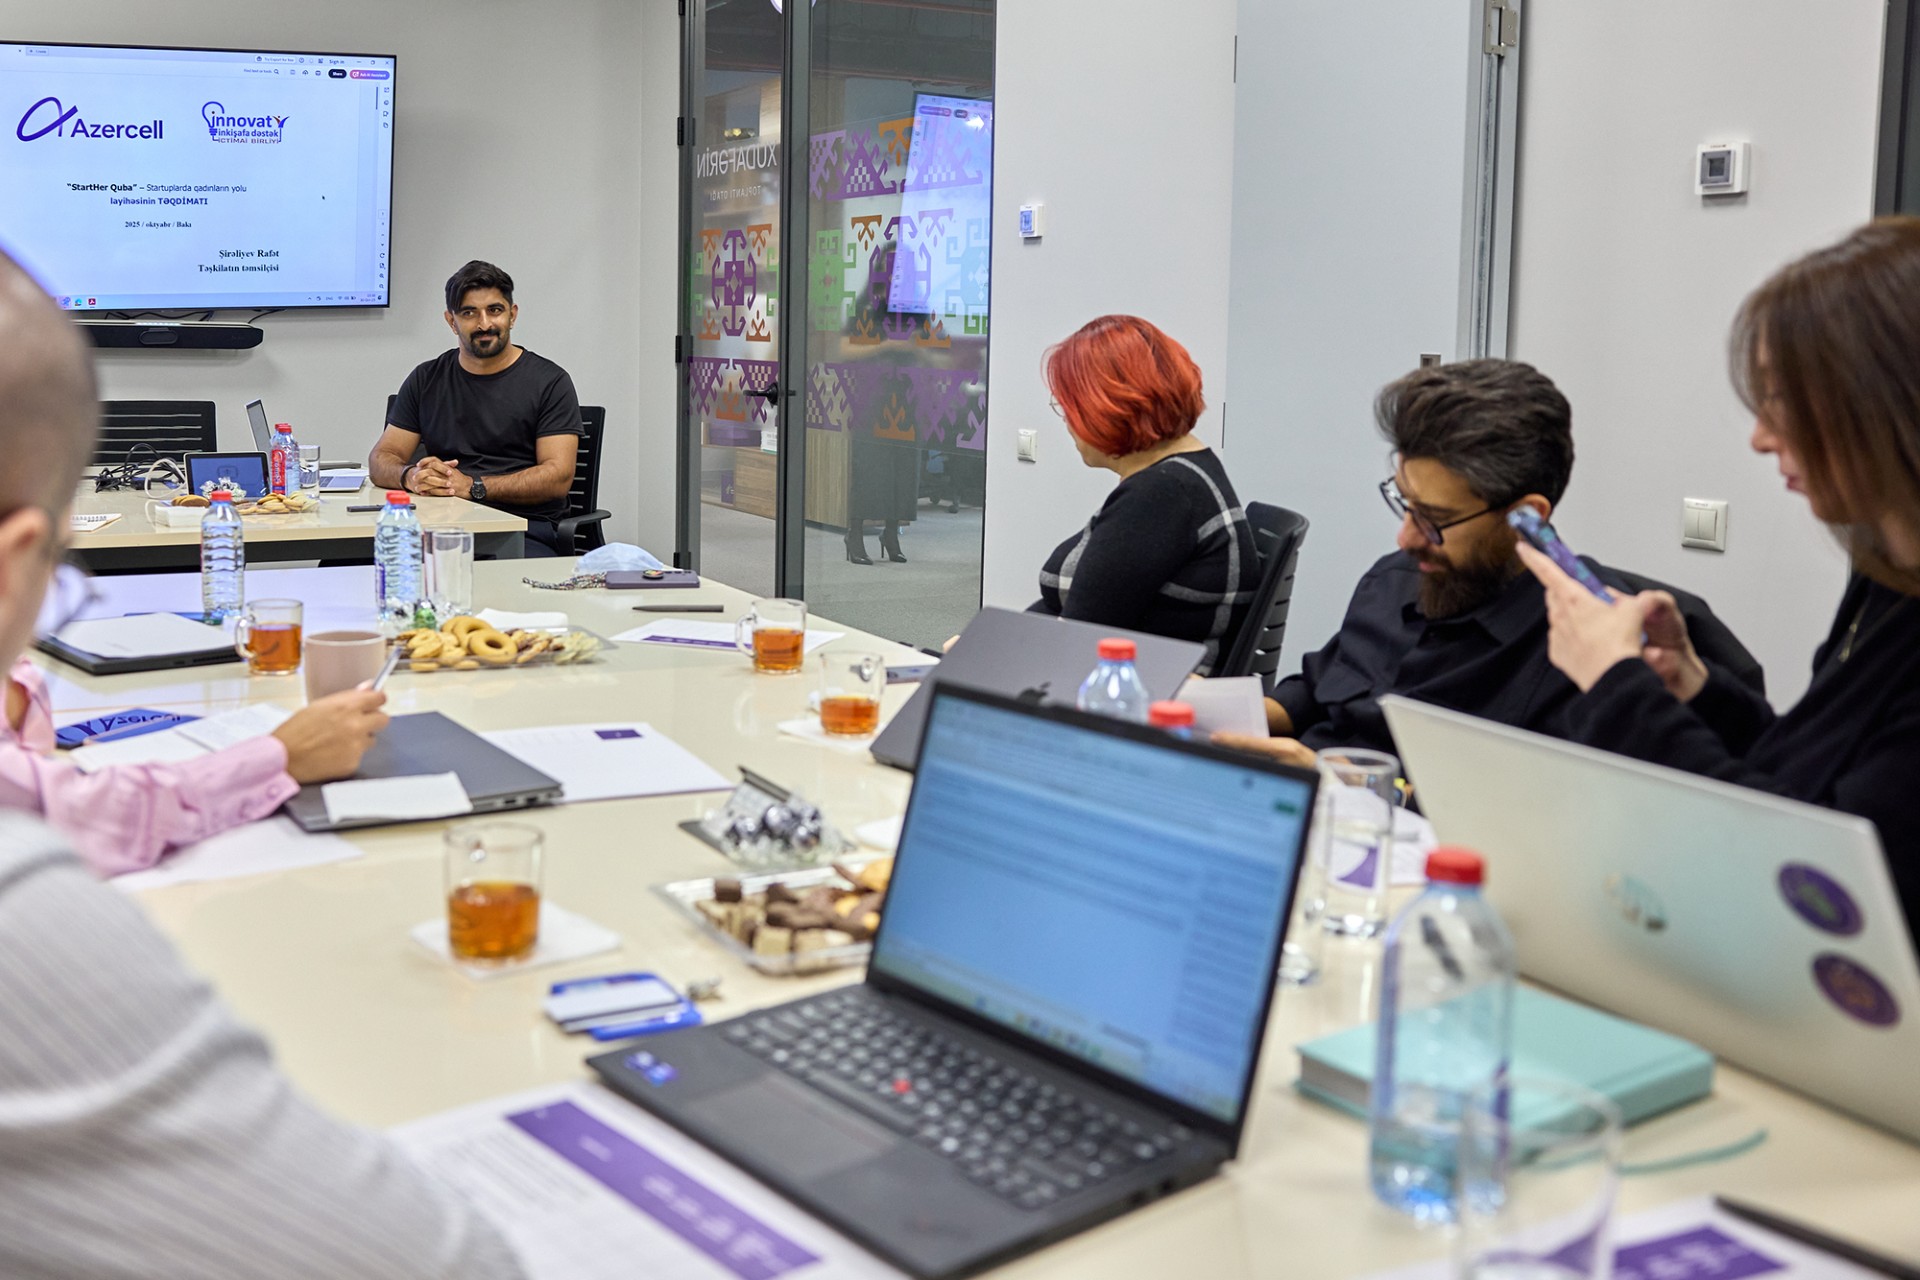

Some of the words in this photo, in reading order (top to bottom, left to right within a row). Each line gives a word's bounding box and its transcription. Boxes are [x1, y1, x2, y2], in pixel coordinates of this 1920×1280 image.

[70, 118, 163, 139] Azercell
[218, 129, 250, 138] inkişafa
[251, 129, 279, 137] dəstək
[146, 184, 192, 193] Startuplarda
[193, 184, 230, 193] qadınların
[231, 185, 247, 193] yolu
[110, 197, 156, 206] layihəsinin
[157, 196, 208, 206] TƏQDİMATI
[145, 221, 171, 229] oktyabr
[218, 249, 255, 259] Şirəliyev
[257, 249, 279, 257] Rafət
[198, 264, 240, 273] Təşkilatın
[241, 264, 279, 273] təmsilçisi
